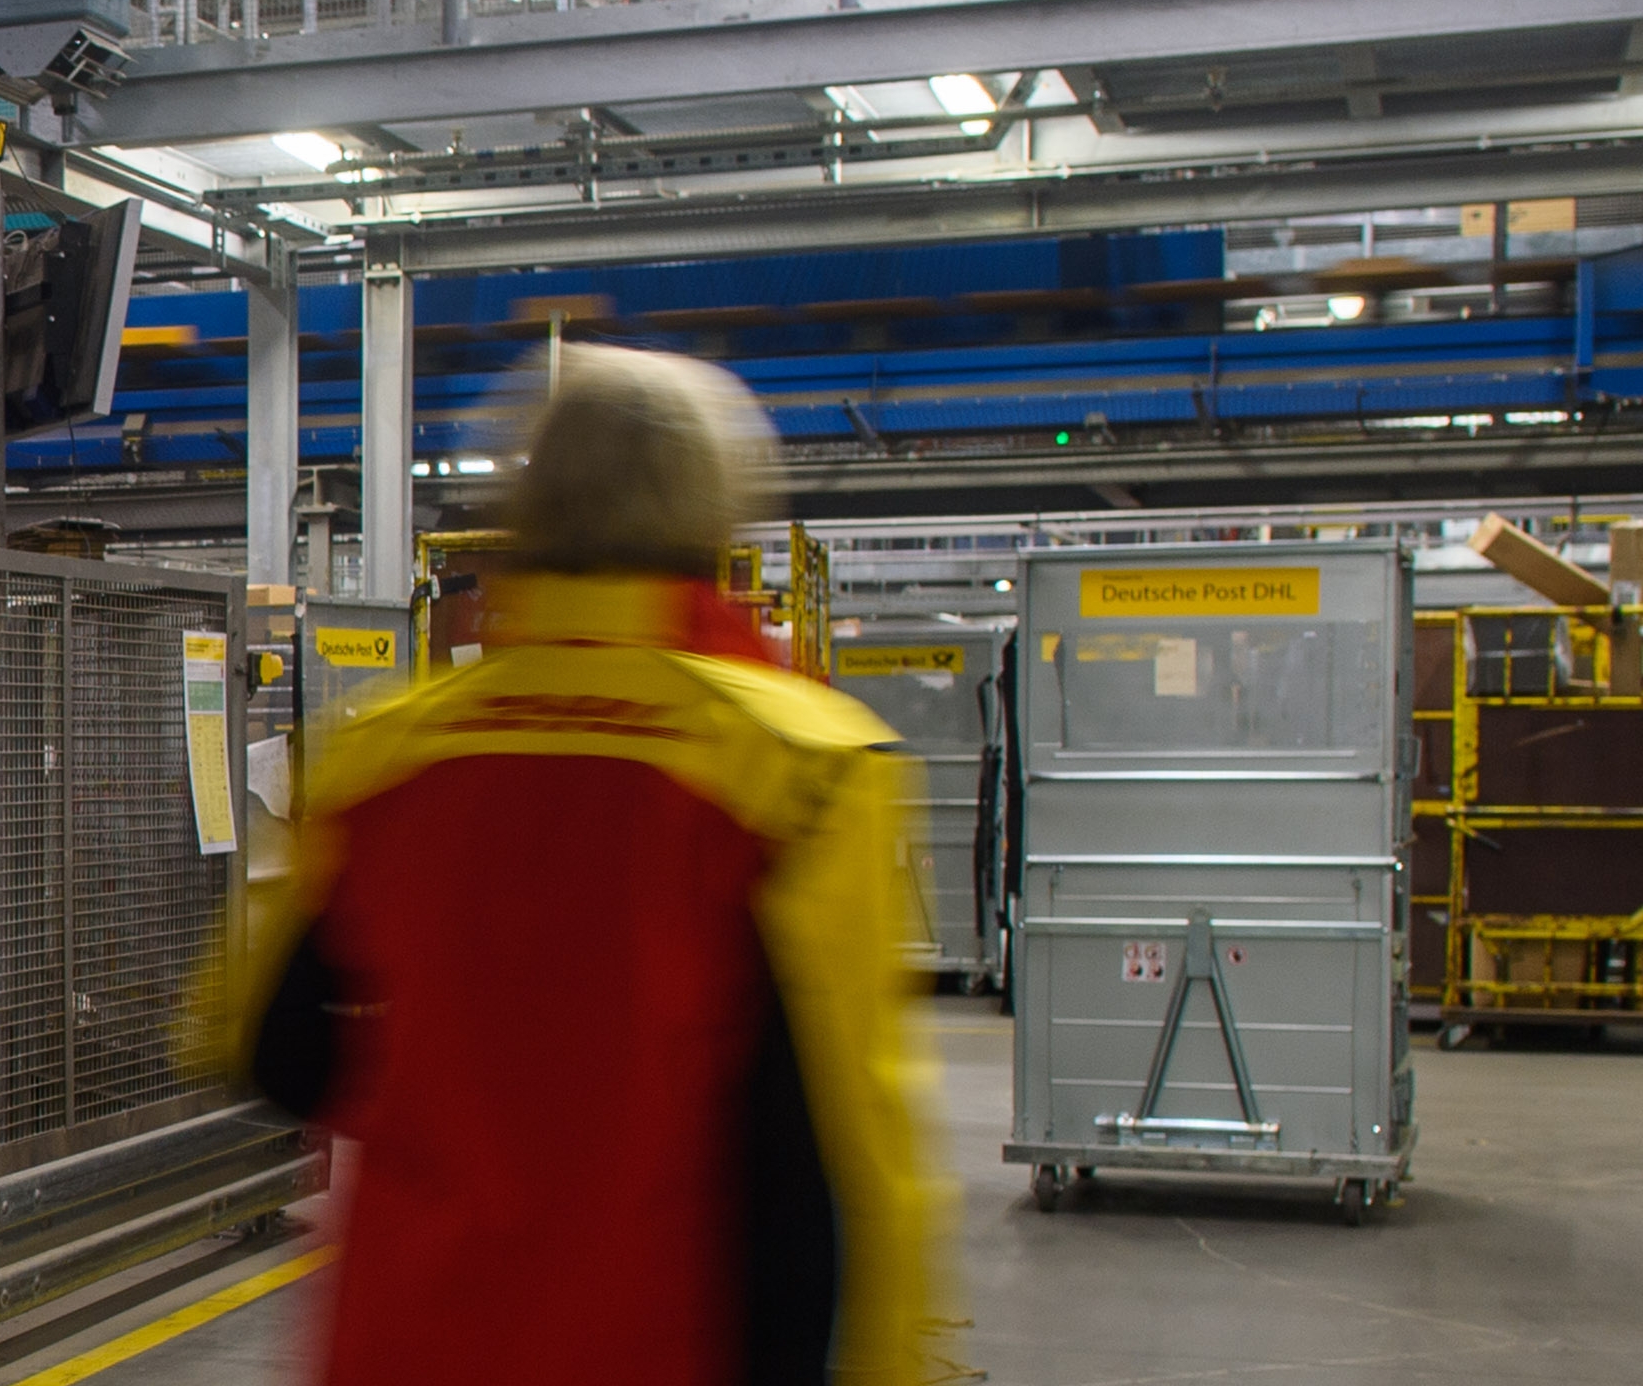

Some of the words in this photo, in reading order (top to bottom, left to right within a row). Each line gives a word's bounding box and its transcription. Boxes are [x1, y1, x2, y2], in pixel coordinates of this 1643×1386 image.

[1101, 581, 1197, 603] Deutsche
[1202, 581, 1246, 603] Post
[1253, 580, 1297, 602] DHL
[321, 641, 354, 656] Deutsche
[356, 643, 372, 656] Post
[845, 656, 898, 668] Deutsche
